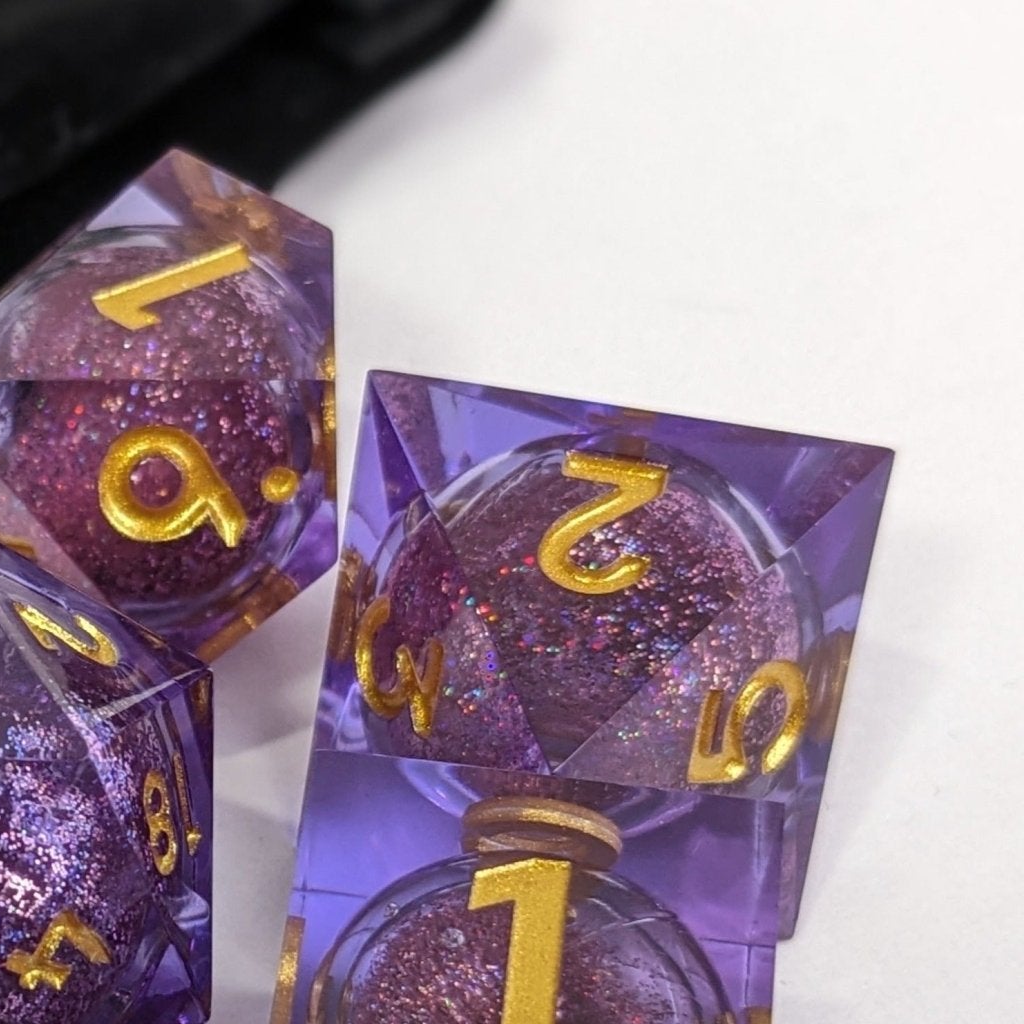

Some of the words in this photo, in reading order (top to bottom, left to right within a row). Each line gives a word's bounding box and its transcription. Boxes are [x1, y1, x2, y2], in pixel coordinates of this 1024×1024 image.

[92, 242, 253, 331] 1
[537, 449, 669, 594] 2
[355, 594, 444, 739] 3
[688, 660, 808, 783] 5
